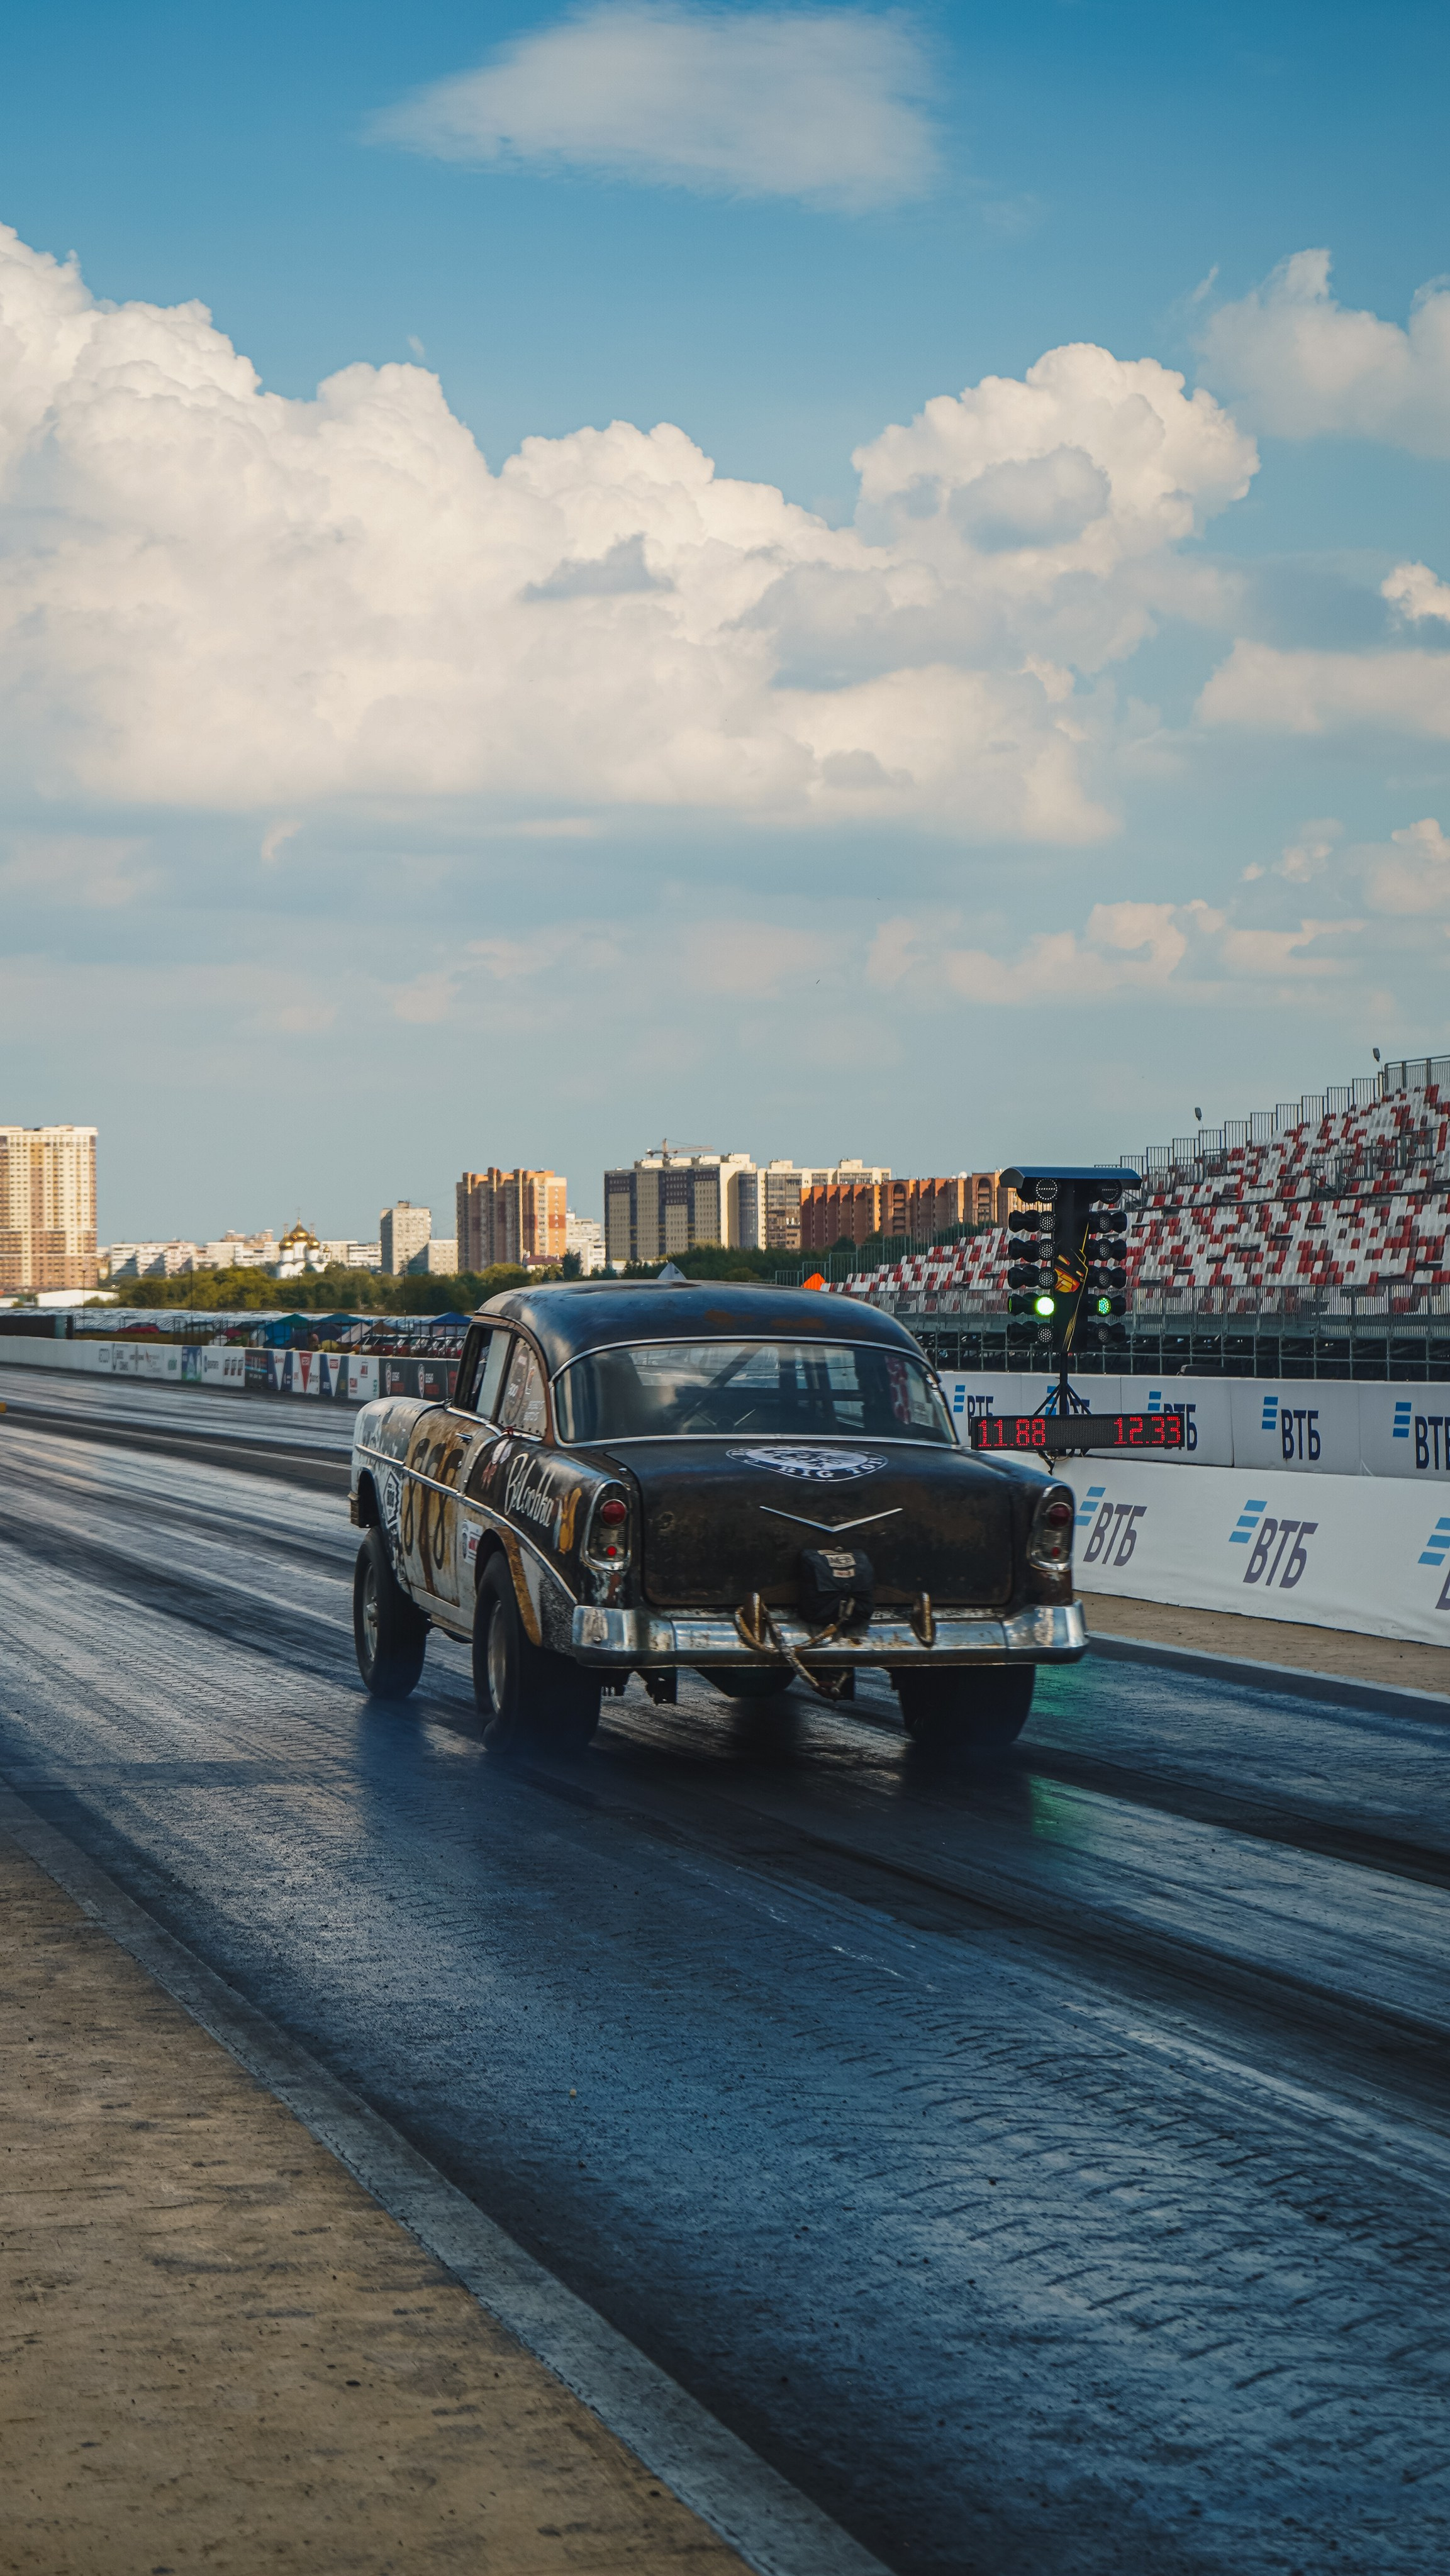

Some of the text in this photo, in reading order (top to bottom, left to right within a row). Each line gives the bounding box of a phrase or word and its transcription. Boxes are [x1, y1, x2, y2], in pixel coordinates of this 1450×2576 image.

[1113, 1416, 1181, 1445] 12.33
[1281, 1409, 1321, 1461] ВТБ
[505, 1452, 556, 1528] Belochka
[778, 1465, 835, 1478] BIG
[1083, 1502, 1147, 1567] ВТБ
[1243, 1518, 1319, 1589] ВТБ
